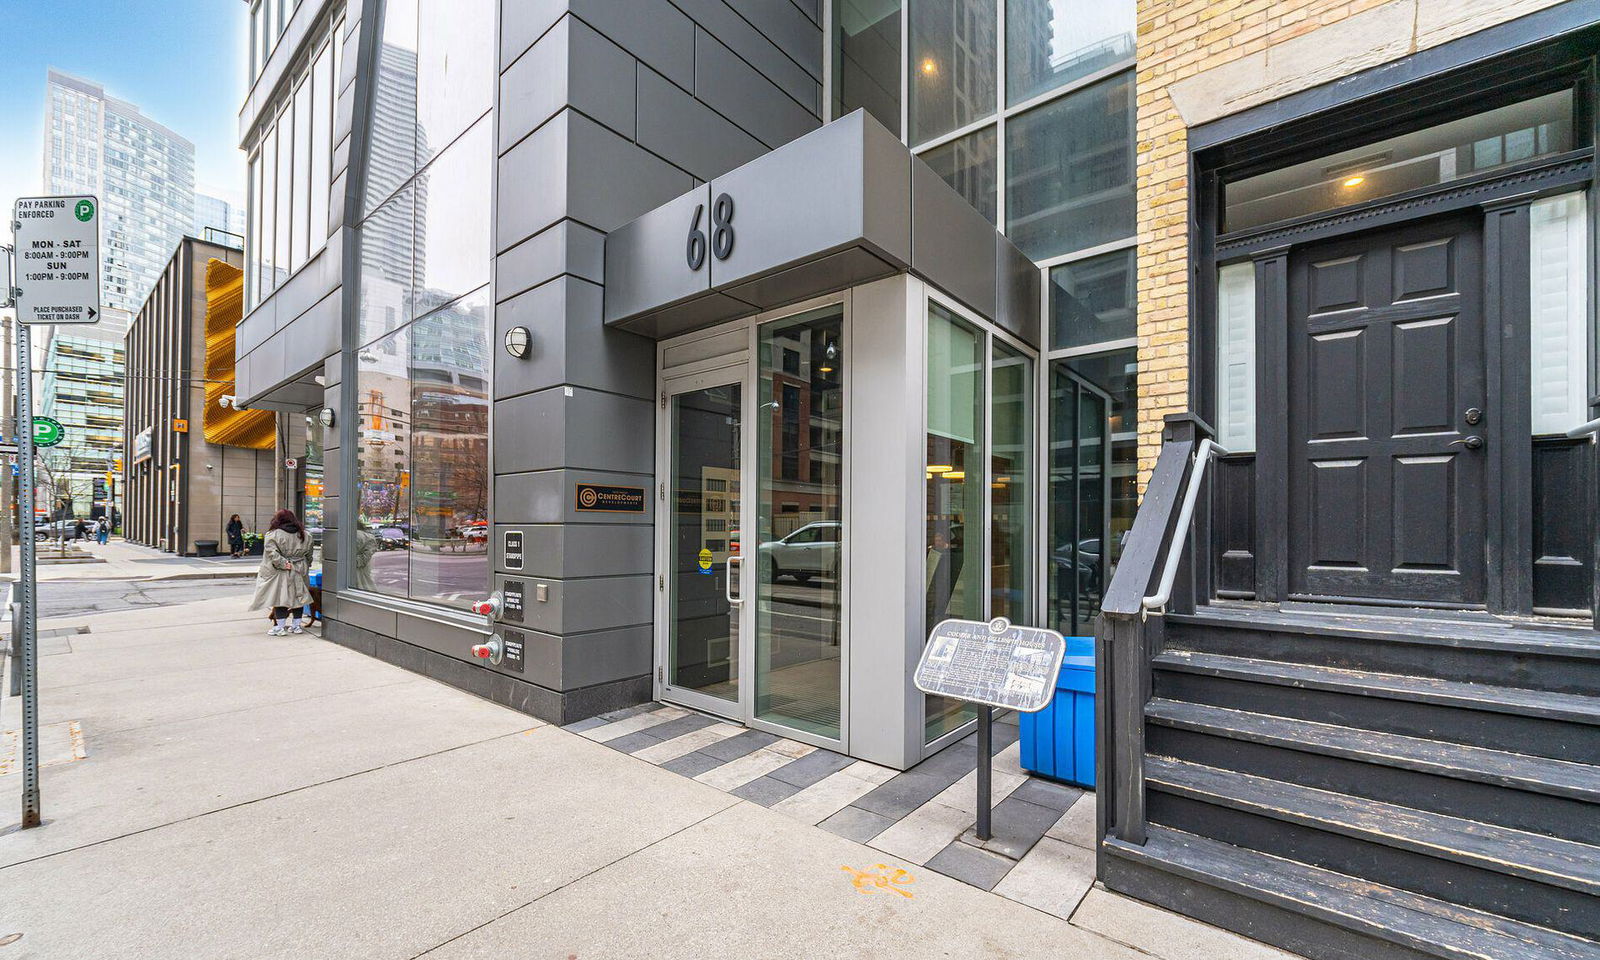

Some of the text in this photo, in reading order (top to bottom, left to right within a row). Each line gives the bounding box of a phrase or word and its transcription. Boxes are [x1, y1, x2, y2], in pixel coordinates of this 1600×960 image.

[18, 200, 66, 209] PAY PARKING
[18, 210, 55, 219] ENFORCED
[686, 192, 735, 271] 68
[32, 241, 54, 249] MON
[63, 240, 82, 248] SAT
[24, 252, 54, 260] 8:00AM
[60, 251, 89, 259] 9:00PM
[47, 262, 67, 270] SUN
[25, 273, 54, 281] 1:00PM
[60, 272, 89, 280] 9:00PM
